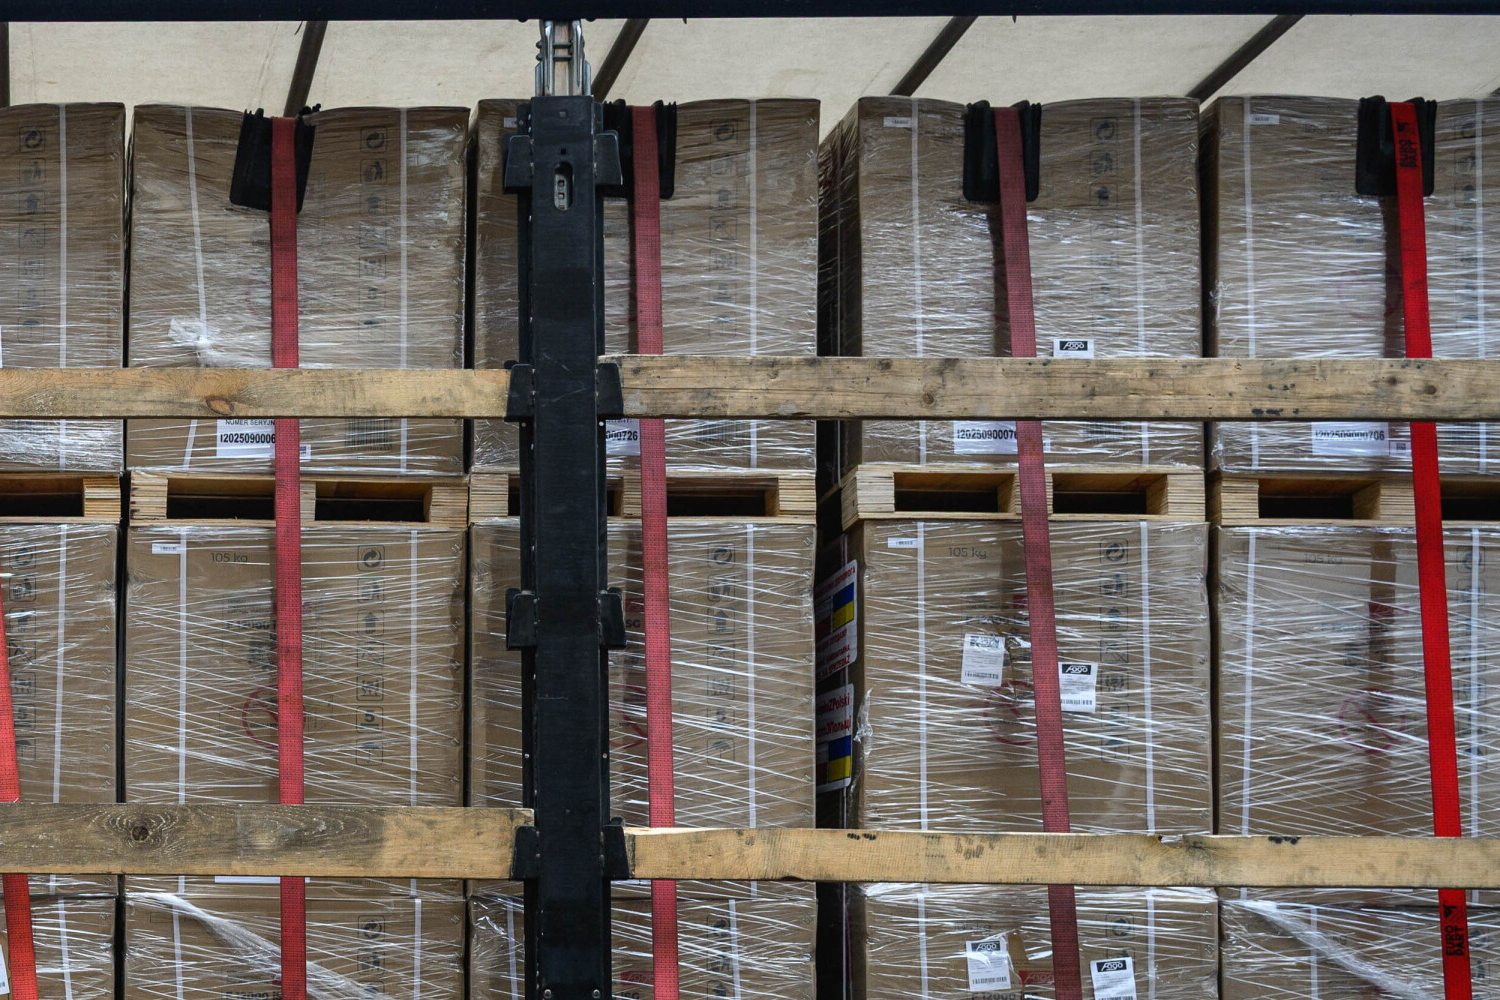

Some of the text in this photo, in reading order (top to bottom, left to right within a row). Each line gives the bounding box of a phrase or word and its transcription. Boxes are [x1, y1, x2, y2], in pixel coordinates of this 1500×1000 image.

[1062, 341, 1086, 350] Fogo
[220, 432, 275, 443] I2025090006
[211, 553, 248, 564] 105 kg
[948, 547, 987, 559] 105 kg
[1066, 665, 1090, 675] Fogo
[1445, 925, 1454, 957] EURO
[1454, 925, 1466, 957] PART
[1101, 961, 1125, 971] Fogo
[981, 992, 1016, 1000] 12000
